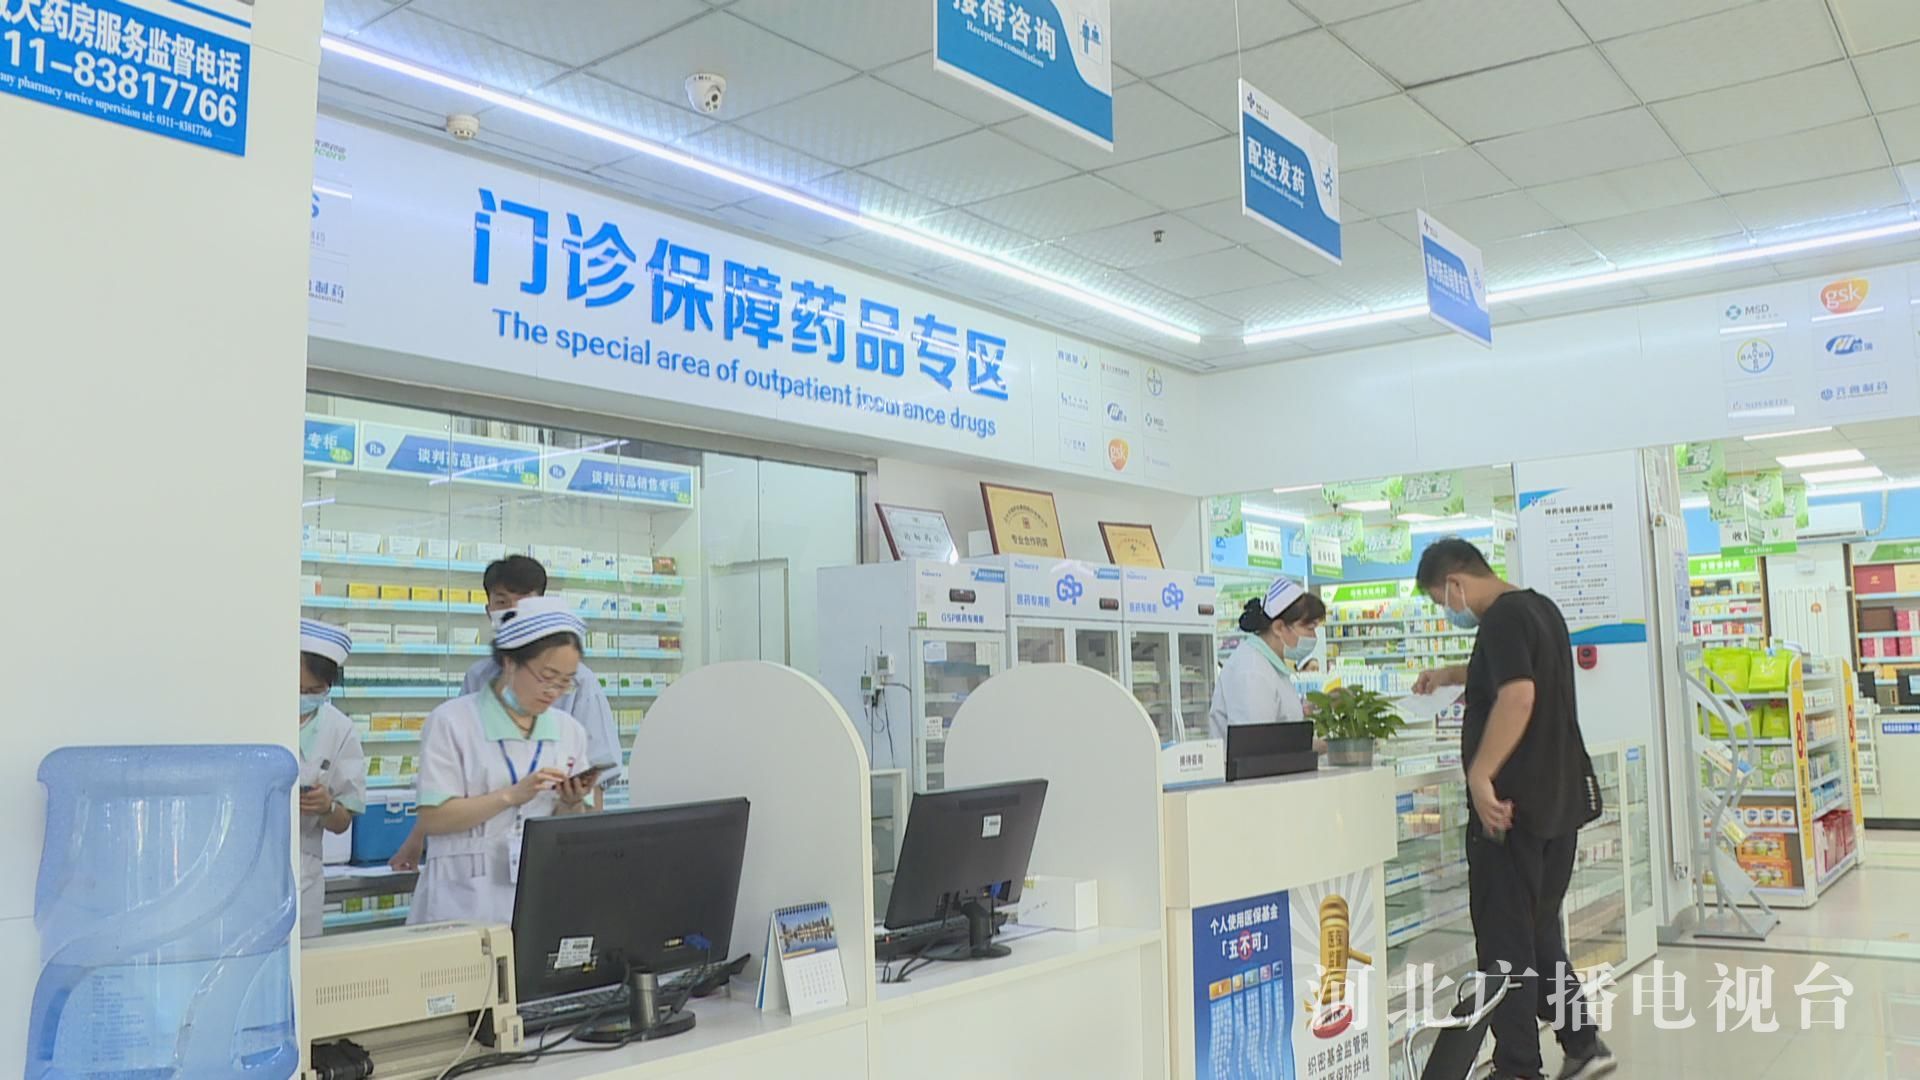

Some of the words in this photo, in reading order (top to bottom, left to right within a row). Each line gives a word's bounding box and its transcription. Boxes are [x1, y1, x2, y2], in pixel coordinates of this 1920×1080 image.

[18, 76, 62, 99] pharmacy
[65, 91, 93, 106] service
[95, 100, 140, 120] supervision
[142, 110, 155, 123] tel:
[1247, 136, 1305, 197] 配送发药
[473, 188, 1009, 401] 门诊保障药品专区
[1745, 303, 1769, 316] MSD
[1825, 281, 1862, 309] gsk
[492, 308, 548, 344] The
[555, 327, 650, 366] special
[657, 347, 711, 378] area
[716, 361, 739, 384] of
[744, 368, 851, 407] outpatient
[951, 406, 997, 439] drugs
[303, 431, 337, 450] 专柜
[369, 443, 382, 455] Rx
[1210, 903, 1279, 936] 个人使用医保基金
[1222, 932, 1269, 960] 「五不可」
[1307, 1031, 1369, 1077] 织密基金监管网
